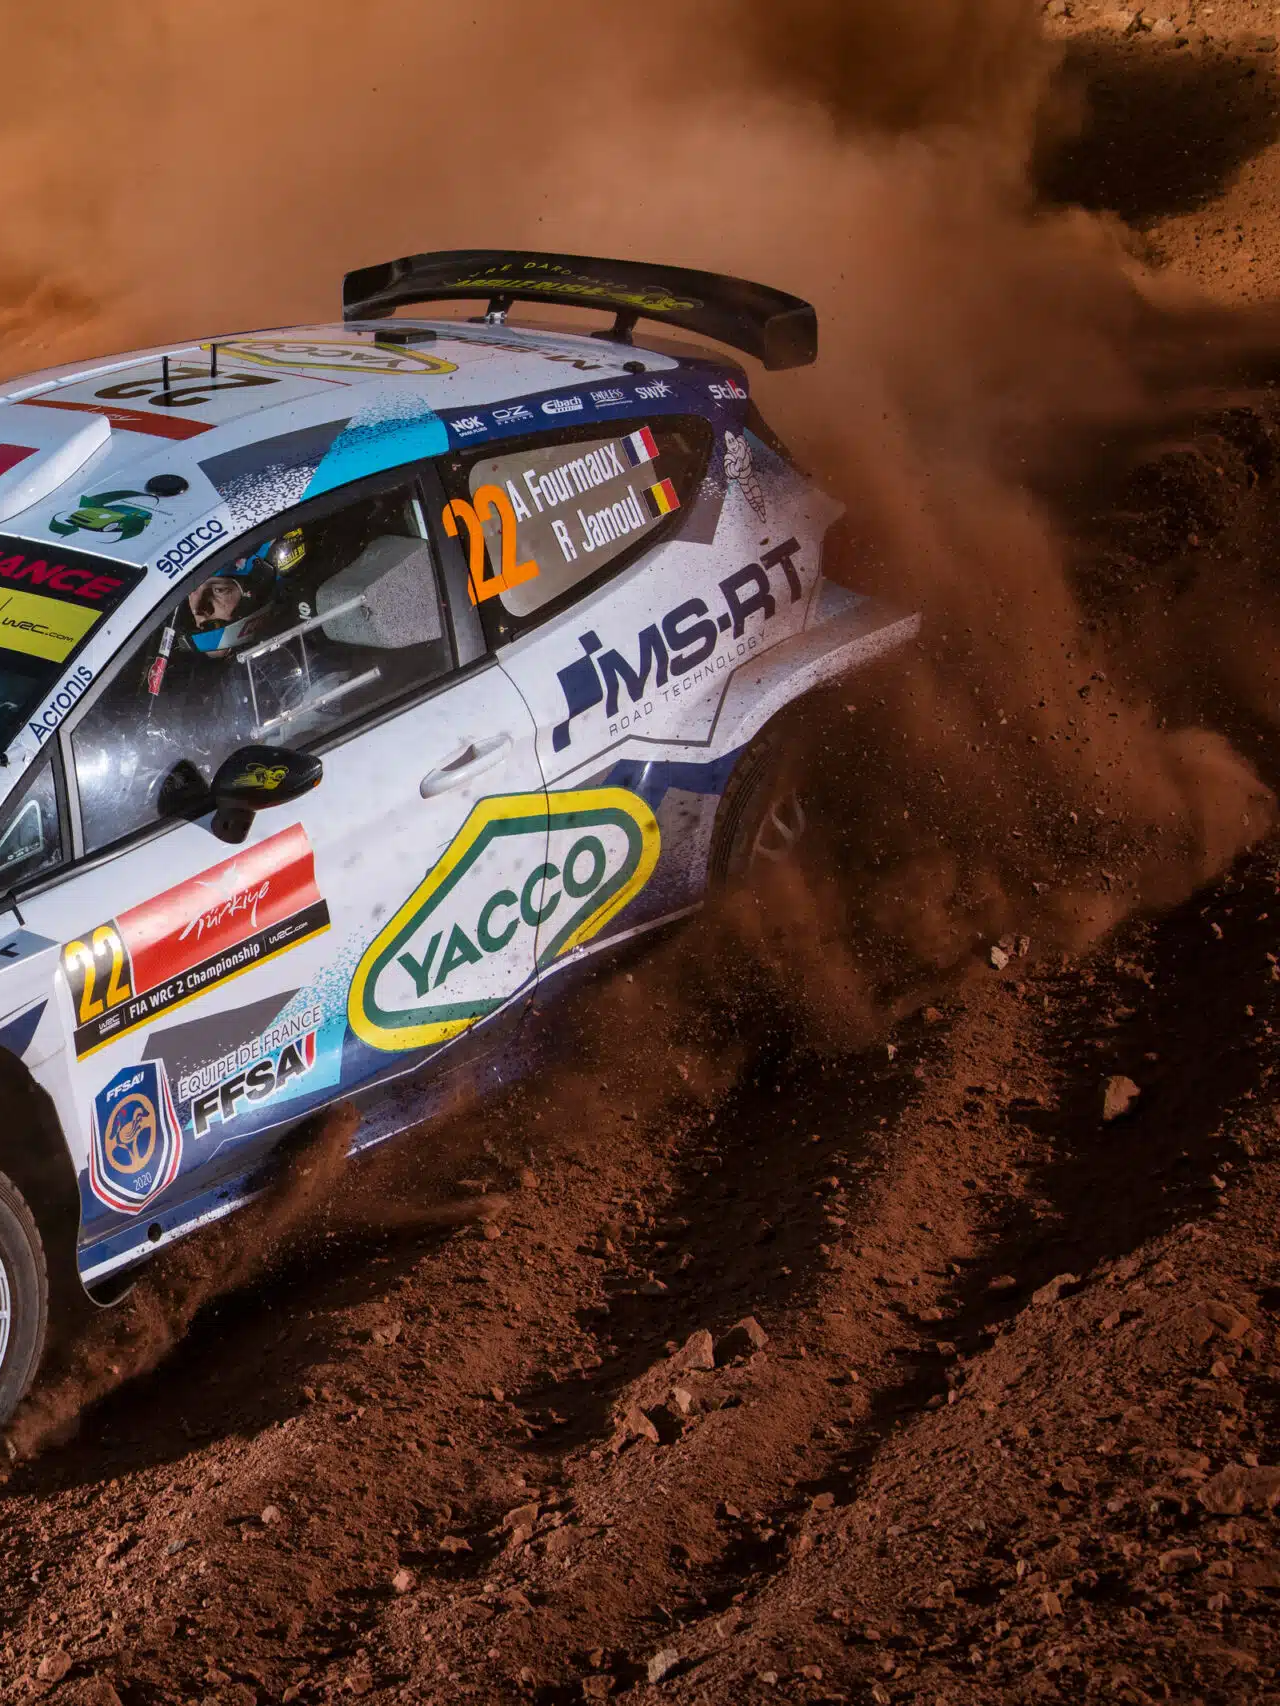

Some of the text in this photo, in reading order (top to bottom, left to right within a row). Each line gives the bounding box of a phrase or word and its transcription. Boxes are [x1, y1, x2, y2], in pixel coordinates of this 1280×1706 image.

[94, 367, 282, 407] 22
[240, 342, 406, 370] YACCO
[450, 416, 485, 433] NGK
[590, 389, 624, 401] ENDLESS
[504, 442, 625, 522] A Fourmaux
[156, 519, 223, 575] sparco
[441, 484, 540, 606] 22
[551, 486, 646, 563] R Jamoul
[29, 665, 93, 744] Acronis
[609, 629, 766, 737] ROAD TECHNOLOGY
[397, 835, 606, 1000] YACCO
[64, 925, 131, 1024] 22
[129, 1002, 148, 1019] FIA
[149, 985, 174, 1013] WRC
[176, 980, 185, 992] 2
[186, 943, 260, 988] Championship
[239, 1044, 259, 1067] DE
[263, 1007, 321, 1051] FRANCE
[133, 1171, 152, 1191] 2020
